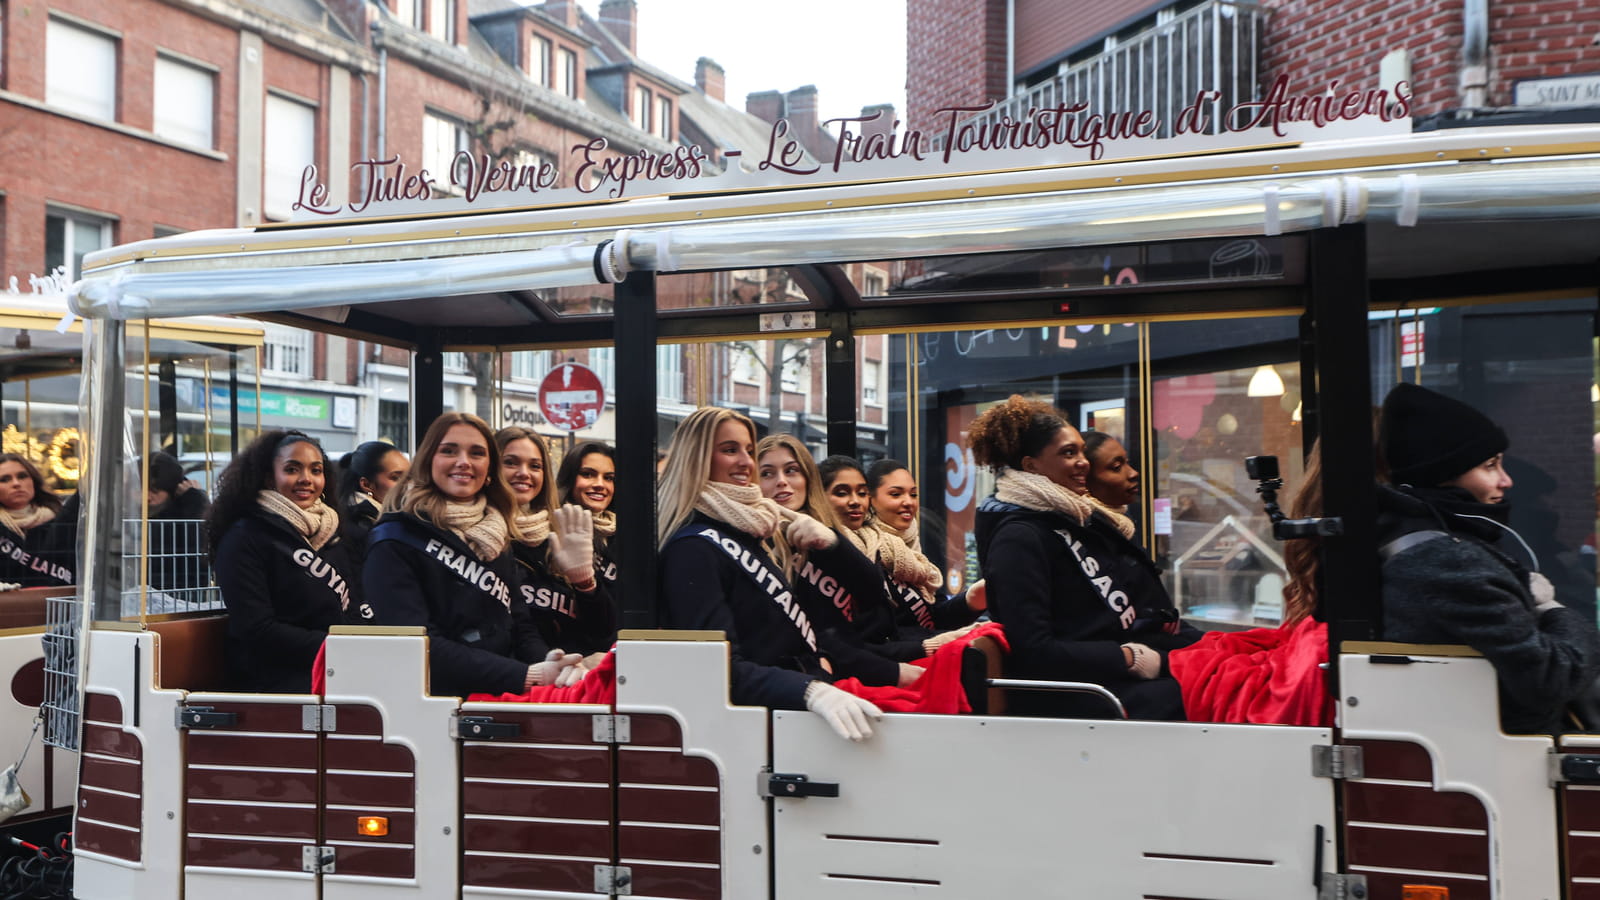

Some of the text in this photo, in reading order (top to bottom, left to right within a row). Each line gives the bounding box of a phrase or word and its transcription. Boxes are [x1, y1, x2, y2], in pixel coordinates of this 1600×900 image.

[291, 165, 342, 215] Le
[348, 154, 436, 213] Jules
[450, 150, 559, 203] Verne
[571, 137, 707, 199] Express
[759, 119, 821, 175] Le
[823, 110, 926, 173] Train
[933, 101, 1162, 164] Touristique
[11, 547, 31, 566] DE
[31, 557, 49, 575] LA
[699, 529, 817, 652] AQUITAINE
[1054, 529, 1136, 629] ALSACE
